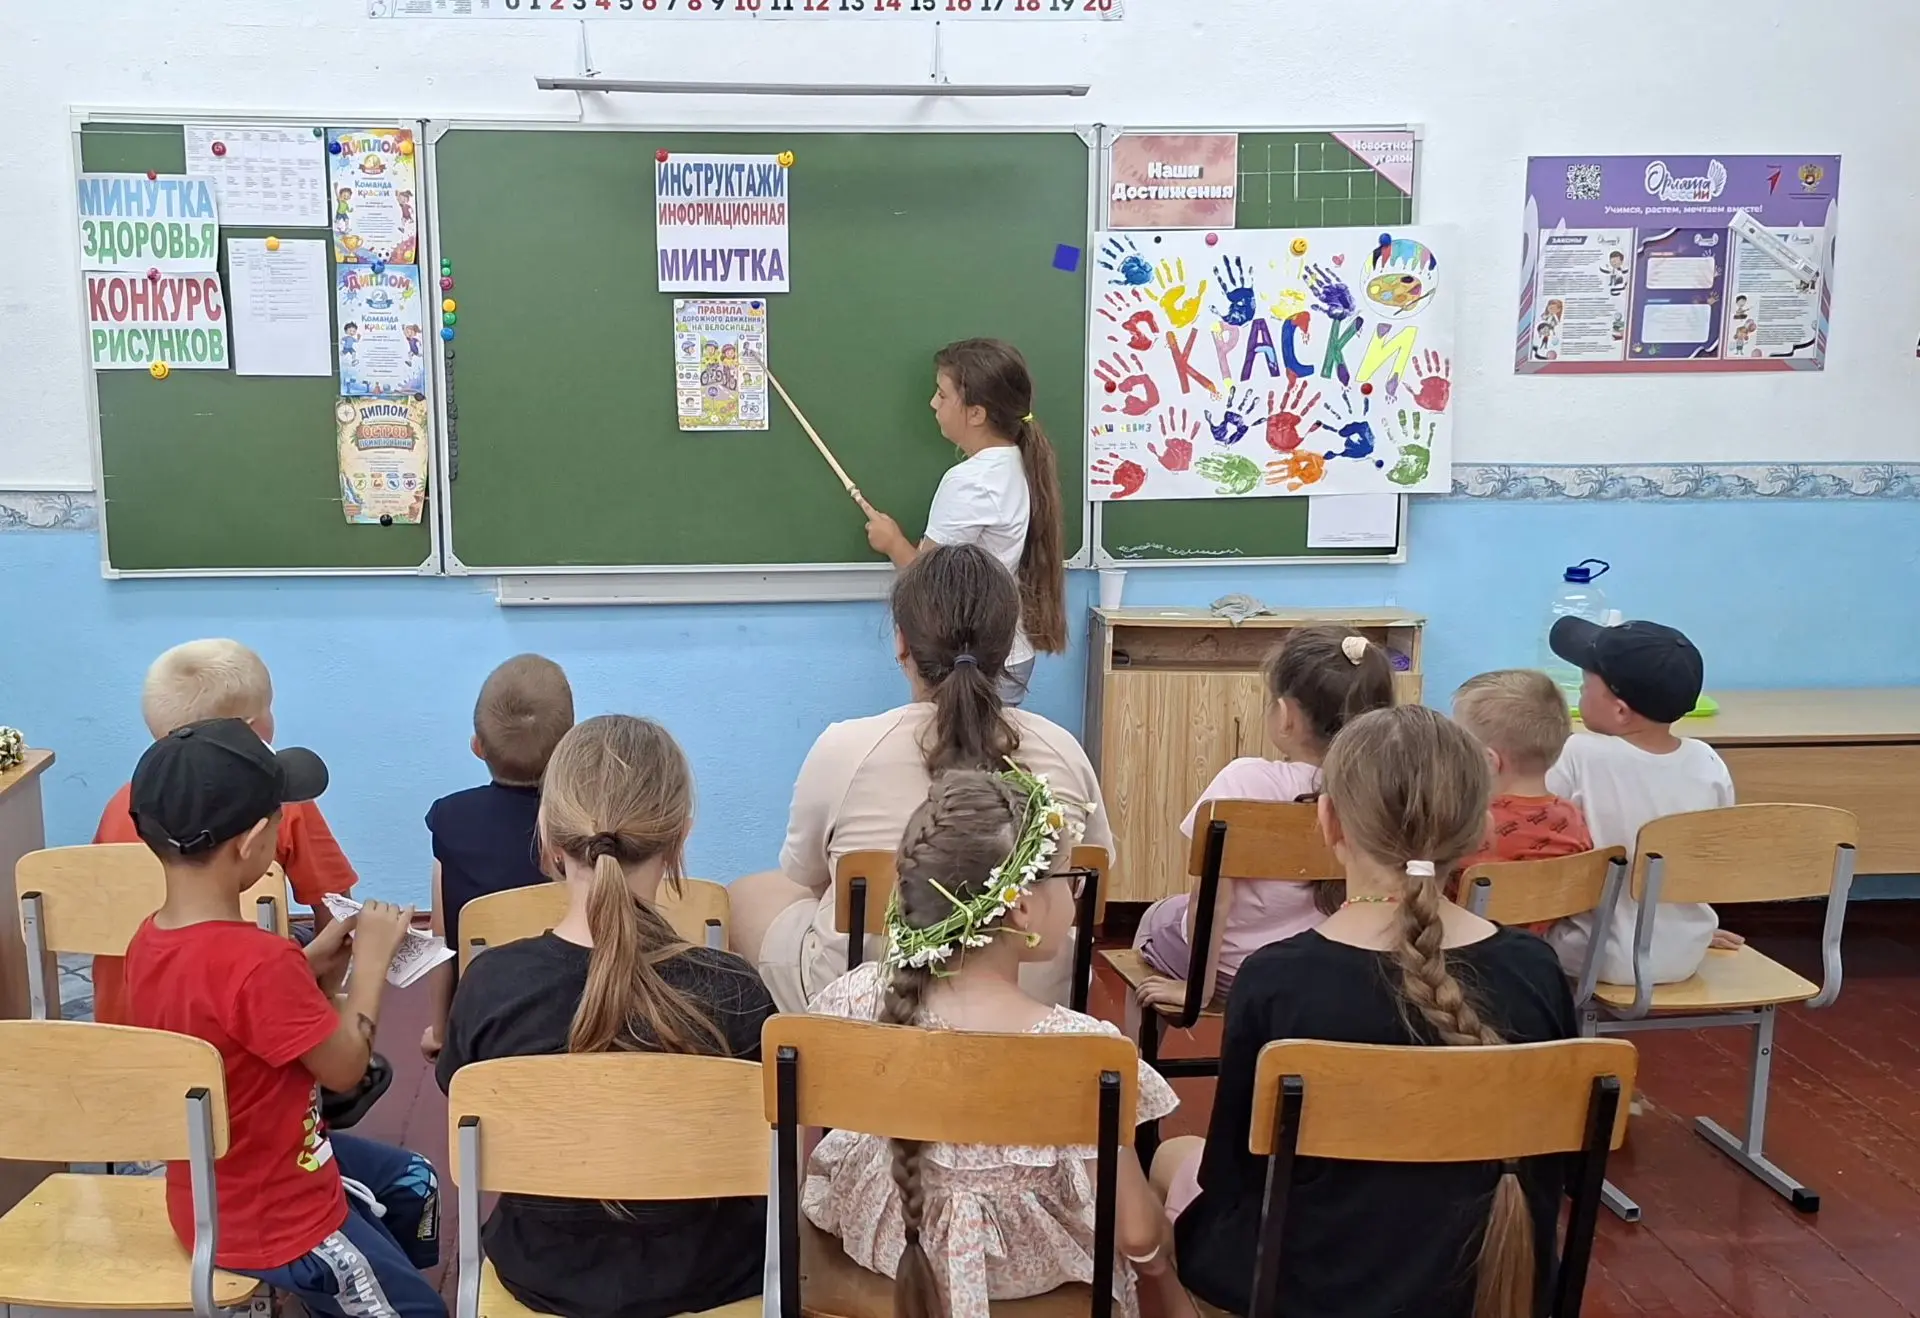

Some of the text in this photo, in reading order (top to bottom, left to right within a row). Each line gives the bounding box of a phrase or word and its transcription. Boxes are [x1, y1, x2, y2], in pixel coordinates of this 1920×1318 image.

[342, 139, 402, 157] ДИПЛОМ
[1148, 161, 1201, 179] Наши
[1647, 162, 1711, 195] Орлята
[354, 180, 392, 189] Команда
[658, 162, 784, 197] ИНСТРУКТАЖИ
[78, 178, 215, 219] МИНУТКА
[1111, 180, 1234, 201] Достижения
[658, 202, 786, 229] ИНФОРМАЦИОННАЯ
[1604, 205, 1643, 214] Учимся,
[1645, 206, 1681, 214] растем,
[82, 219, 216, 264] ЗДОРОВЬЯ
[660, 248, 785, 282] МИНУТКА
[348, 272, 410, 290] ДИПЛОМ
[88, 276, 222, 322] КОНКУРС
[361, 314, 399, 323] Команда
[682, 315, 723, 323] ДОРОЖНОГО
[697, 305, 742, 315] ПРАВИЛА
[692, 323, 755, 332] НА ВЕЛОСИПЕДЕ
[92, 327, 225, 364] РИСУНКОВ
[1166, 310, 1418, 397] КРАСКИ
[360, 404, 409, 420] ДИПЛОМ
[363, 425, 408, 438] ОСТРОВ
